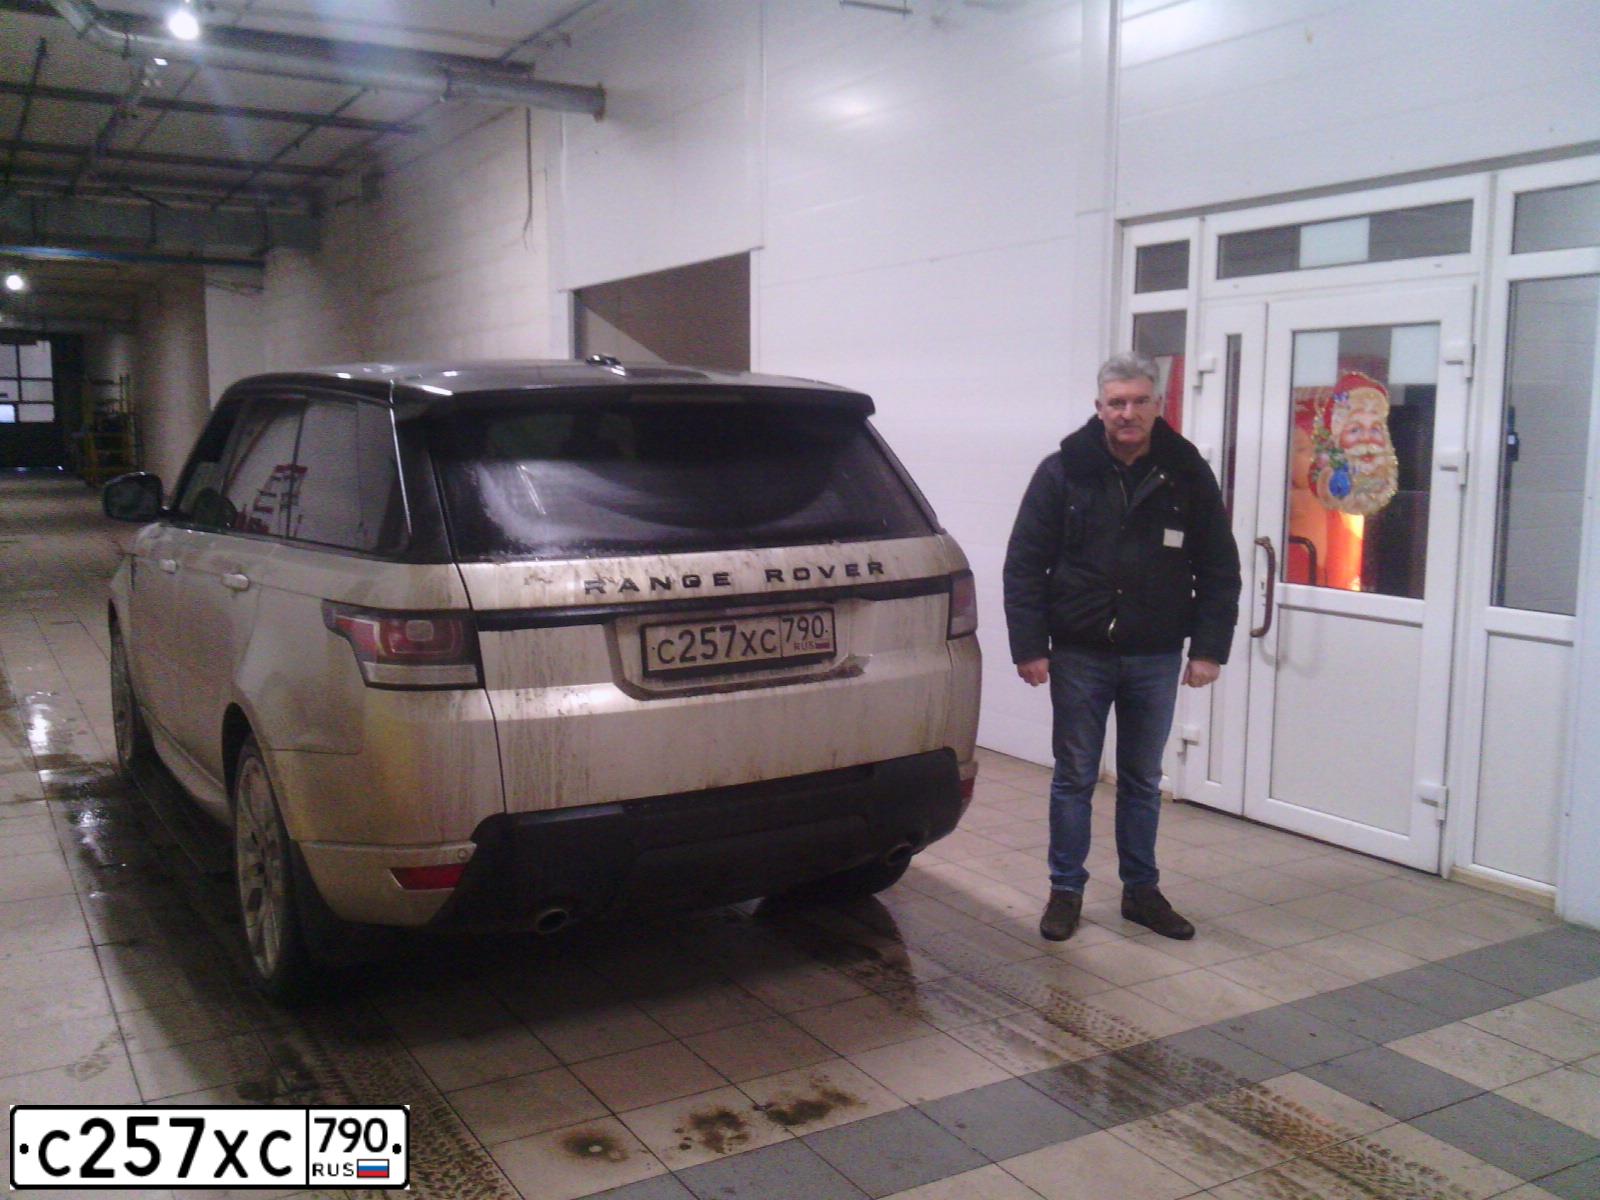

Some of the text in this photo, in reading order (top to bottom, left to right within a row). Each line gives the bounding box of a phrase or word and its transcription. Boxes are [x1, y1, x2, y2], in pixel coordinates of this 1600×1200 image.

[584, 560, 886, 595] RANGE ROVER
[657, 614, 825, 664] C257XC 790
